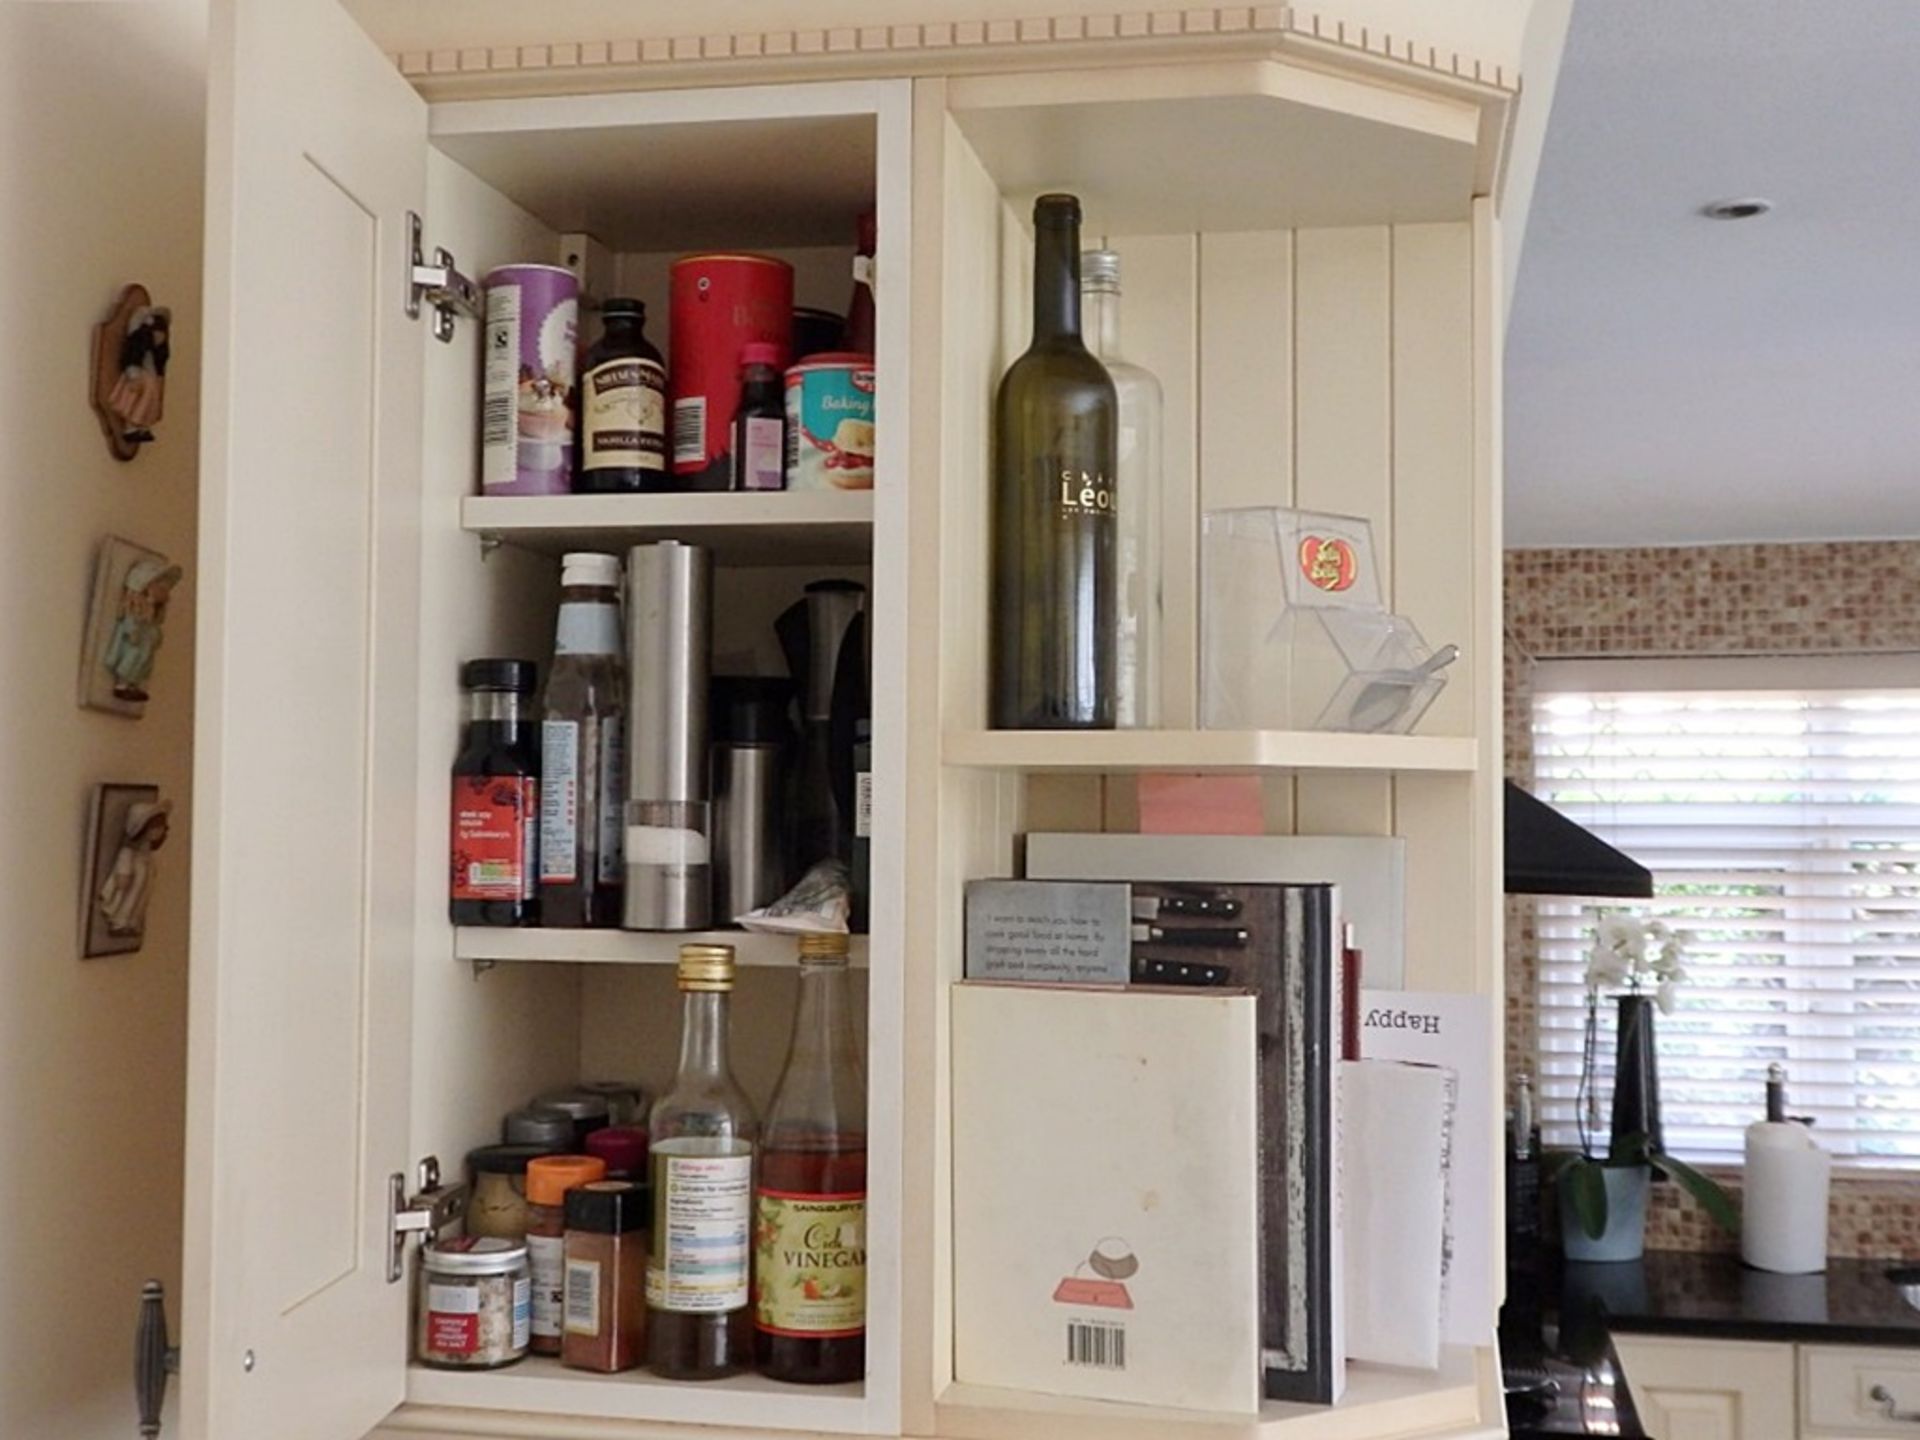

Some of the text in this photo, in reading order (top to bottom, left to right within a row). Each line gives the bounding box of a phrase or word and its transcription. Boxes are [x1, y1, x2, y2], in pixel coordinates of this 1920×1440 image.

[822, 395, 870, 417] Baking
[597, 436, 637, 447] VANILLA
[1027, 915, 1050, 924] teach
[1053, 917, 1067, 926] you
[1008, 930, 1030, 941] good
[1032, 929, 1052, 940] food
[1364, 1009, 1440, 1033] Happy
